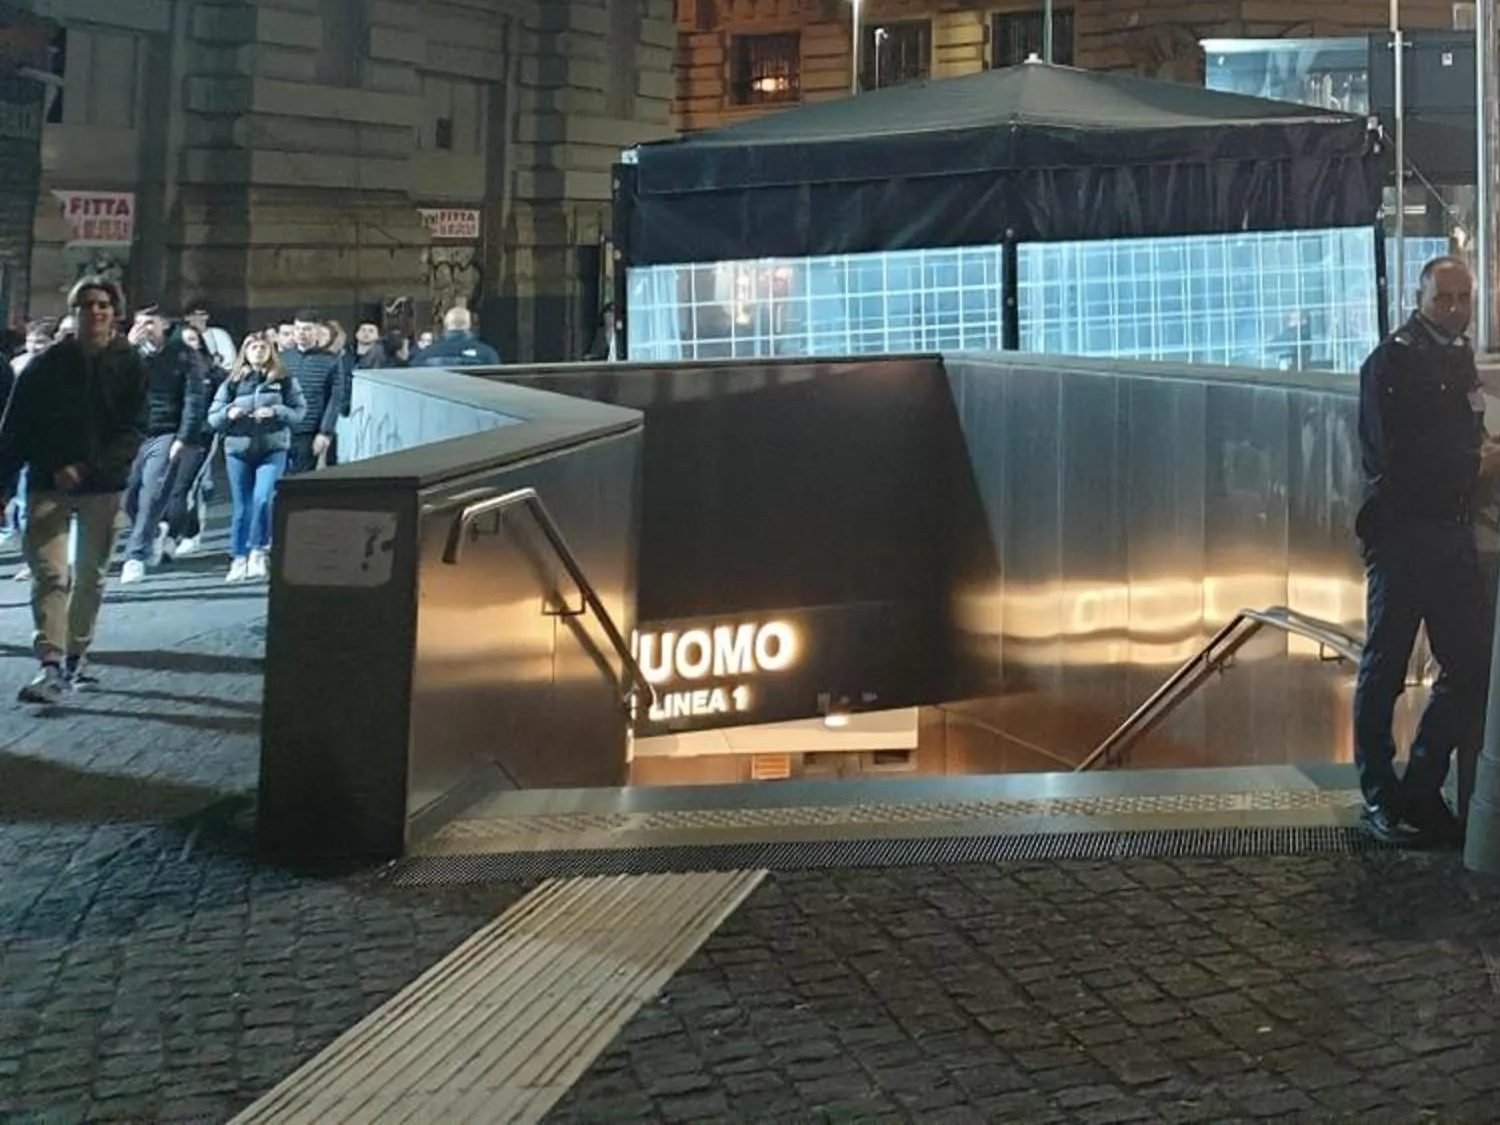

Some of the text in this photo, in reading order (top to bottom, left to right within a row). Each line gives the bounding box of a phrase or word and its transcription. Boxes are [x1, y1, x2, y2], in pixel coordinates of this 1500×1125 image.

[69, 196, 130, 216] FITTA
[648, 684, 751, 720] LINEA 1
